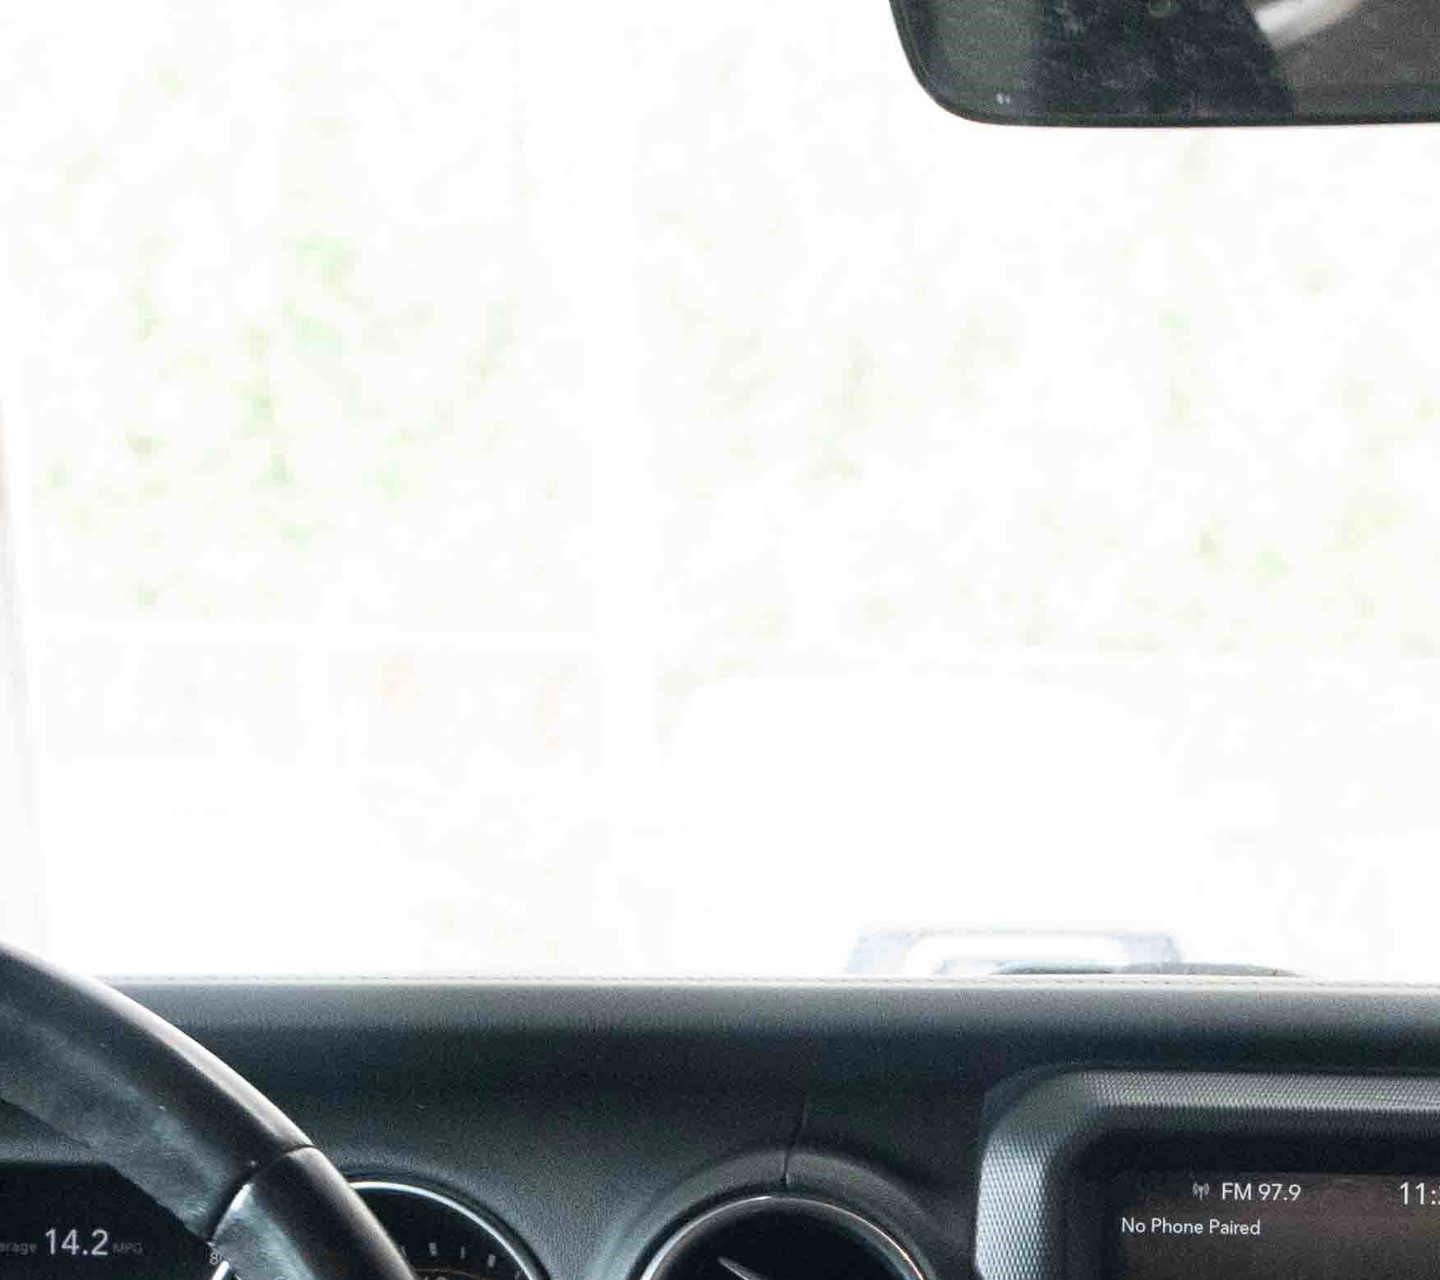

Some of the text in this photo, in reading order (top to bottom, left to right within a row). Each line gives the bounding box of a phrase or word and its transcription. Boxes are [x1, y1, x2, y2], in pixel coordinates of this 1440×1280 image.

[1222, 1182, 1301, 1201] FM 97.9
[1122, 1217, 1260, 1235] No Phone Paired
[46, 1229, 108, 1255] 14.2
